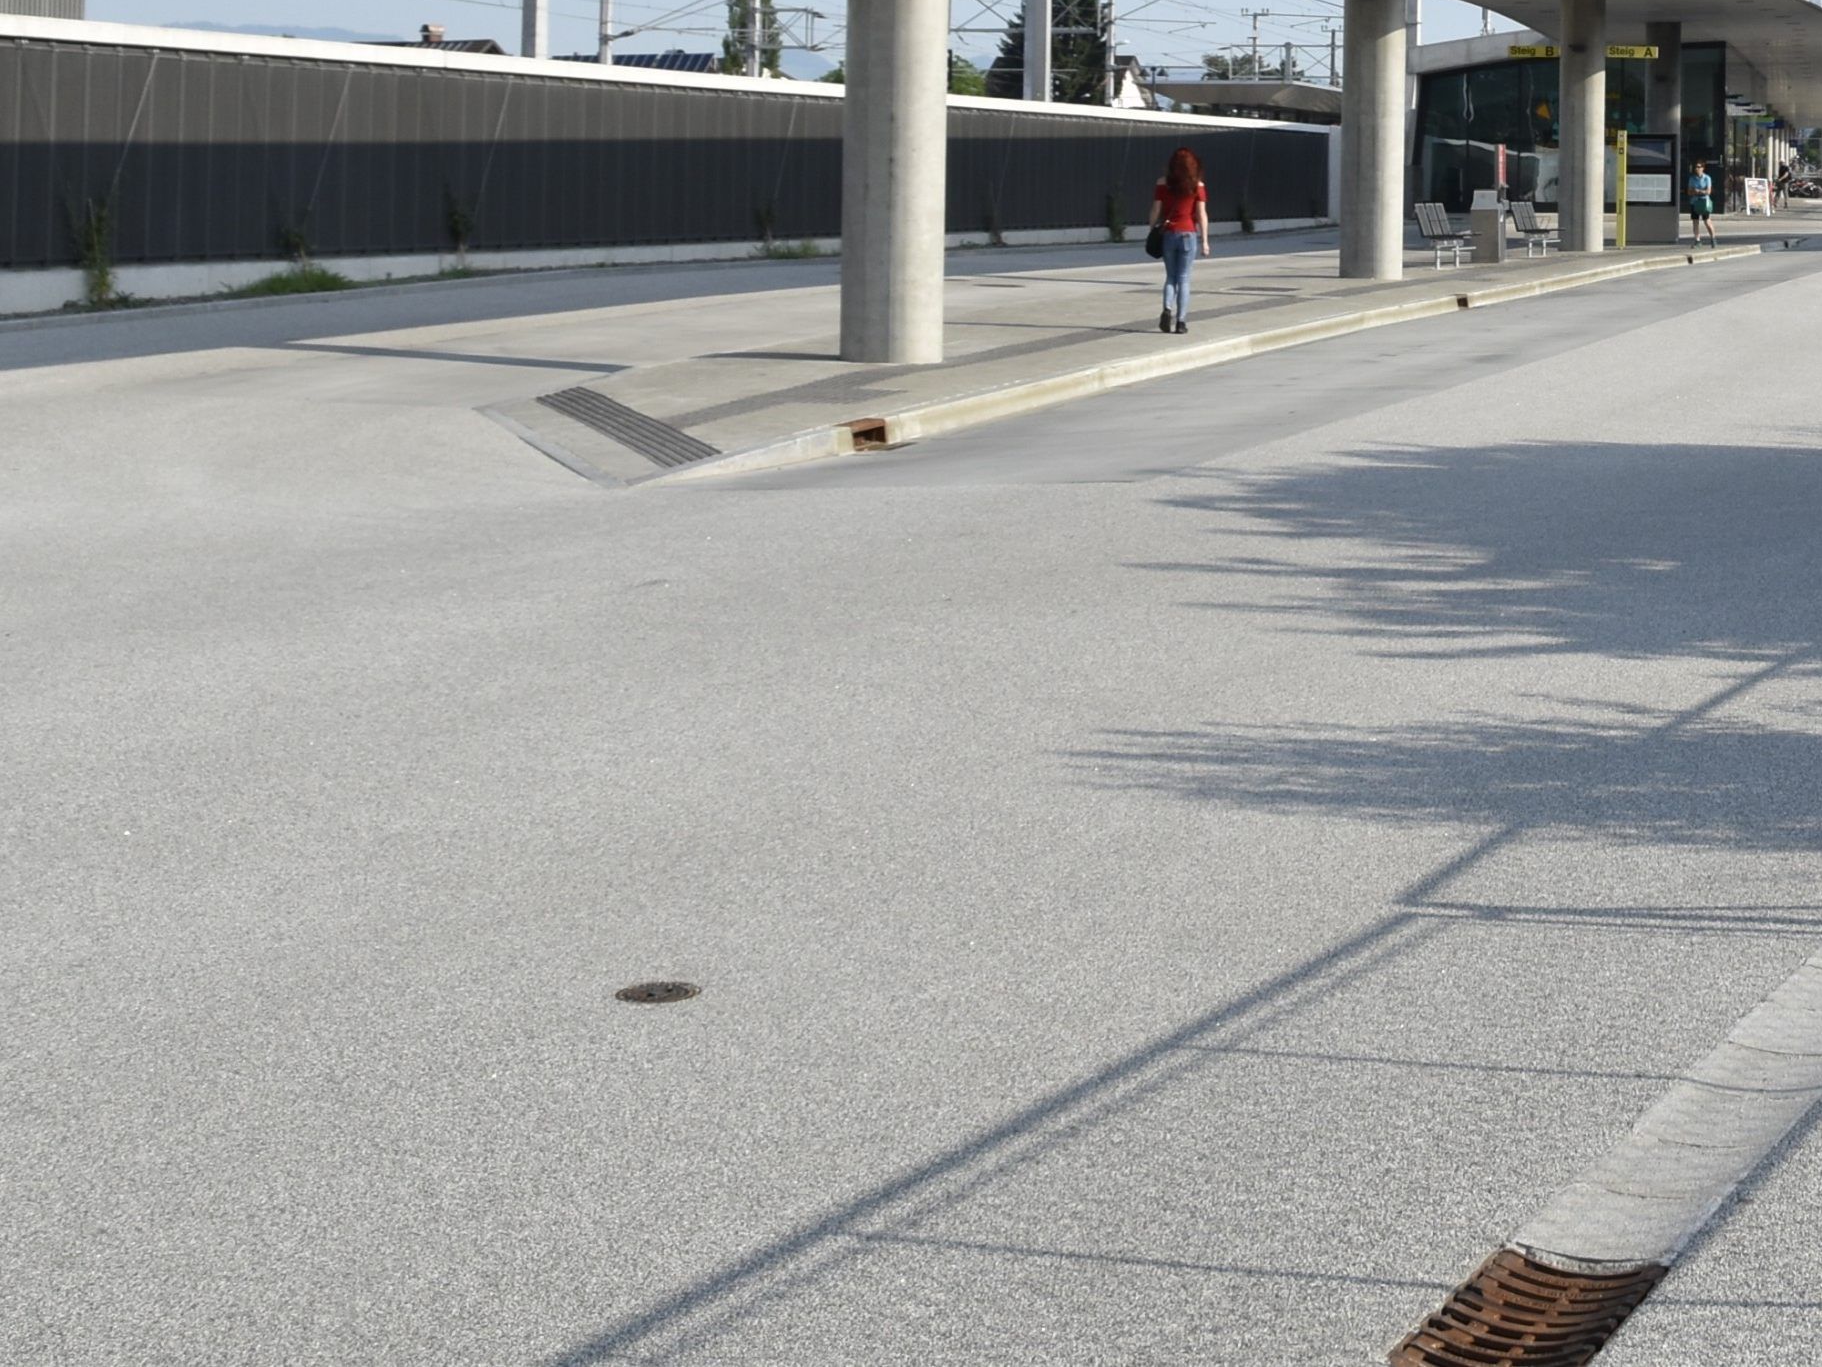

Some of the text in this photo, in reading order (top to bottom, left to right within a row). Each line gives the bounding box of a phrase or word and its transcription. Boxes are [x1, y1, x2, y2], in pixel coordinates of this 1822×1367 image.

[1510, 46, 1554, 57] Steig B
[1609, 46, 1653, 57] Steig A
